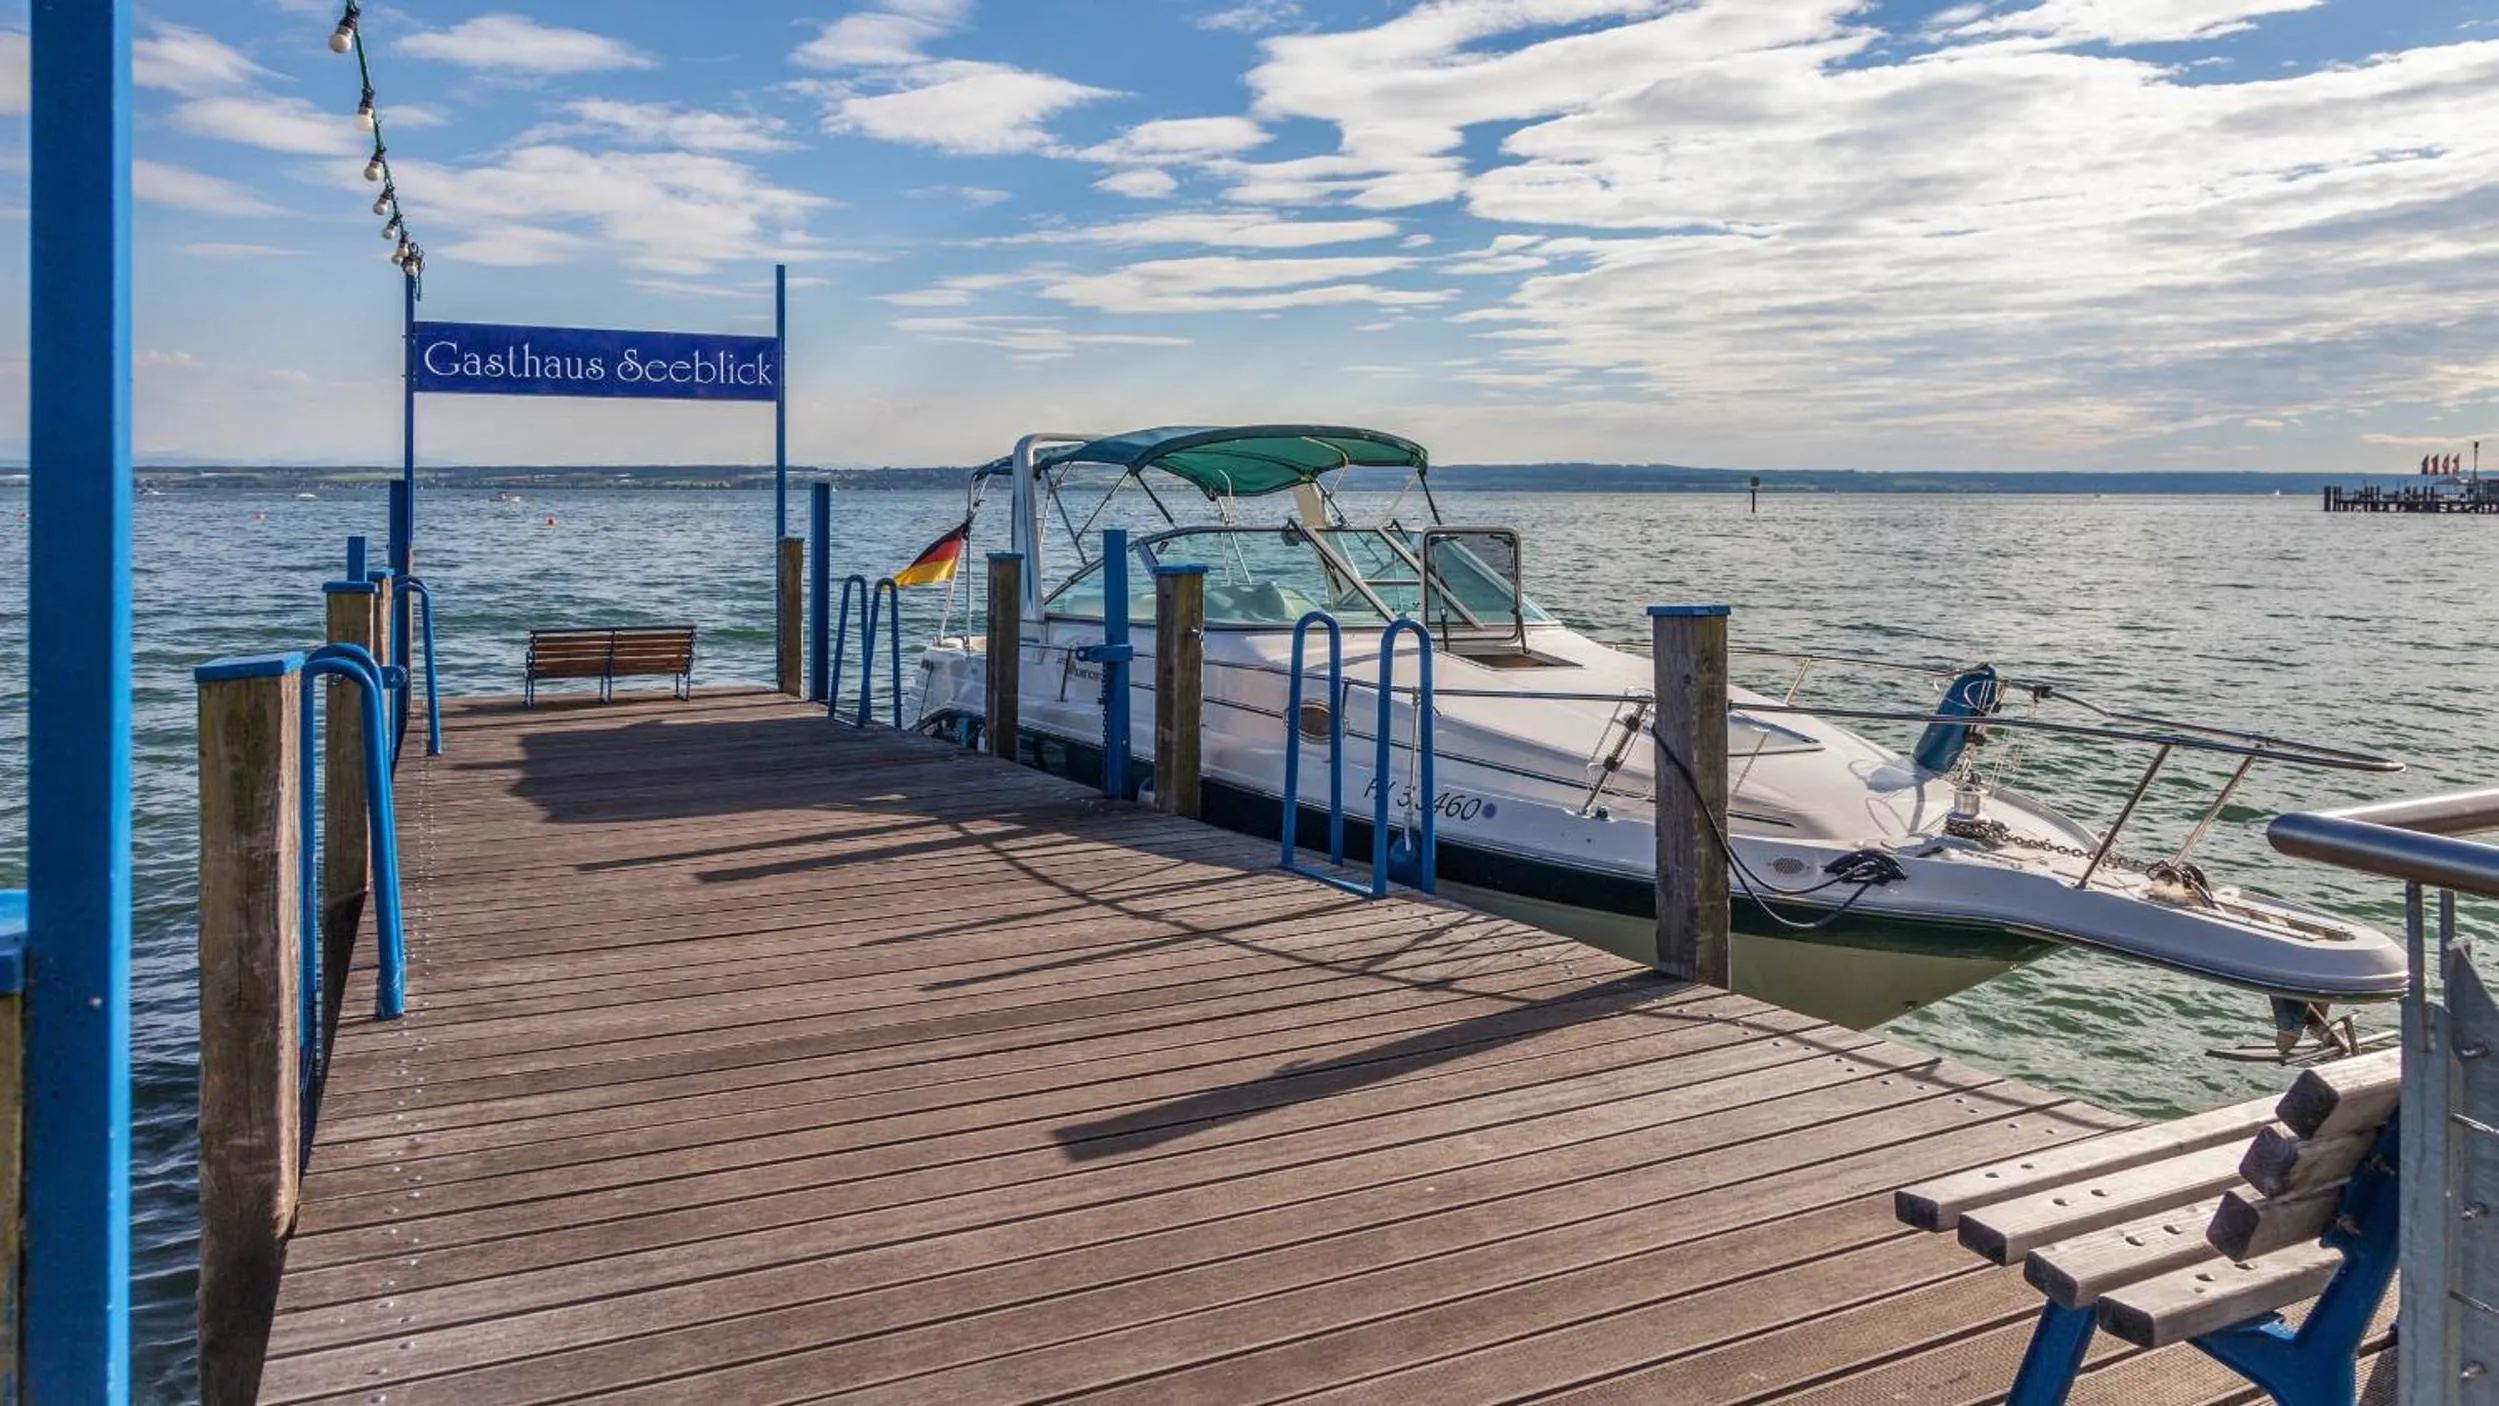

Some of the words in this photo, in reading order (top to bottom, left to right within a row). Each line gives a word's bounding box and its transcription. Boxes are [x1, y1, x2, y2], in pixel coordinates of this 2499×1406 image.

[424, 340, 605, 381] Gasthaus
[616, 348, 774, 386] Seeblick
[1397, 785, 1482, 821] 3460
